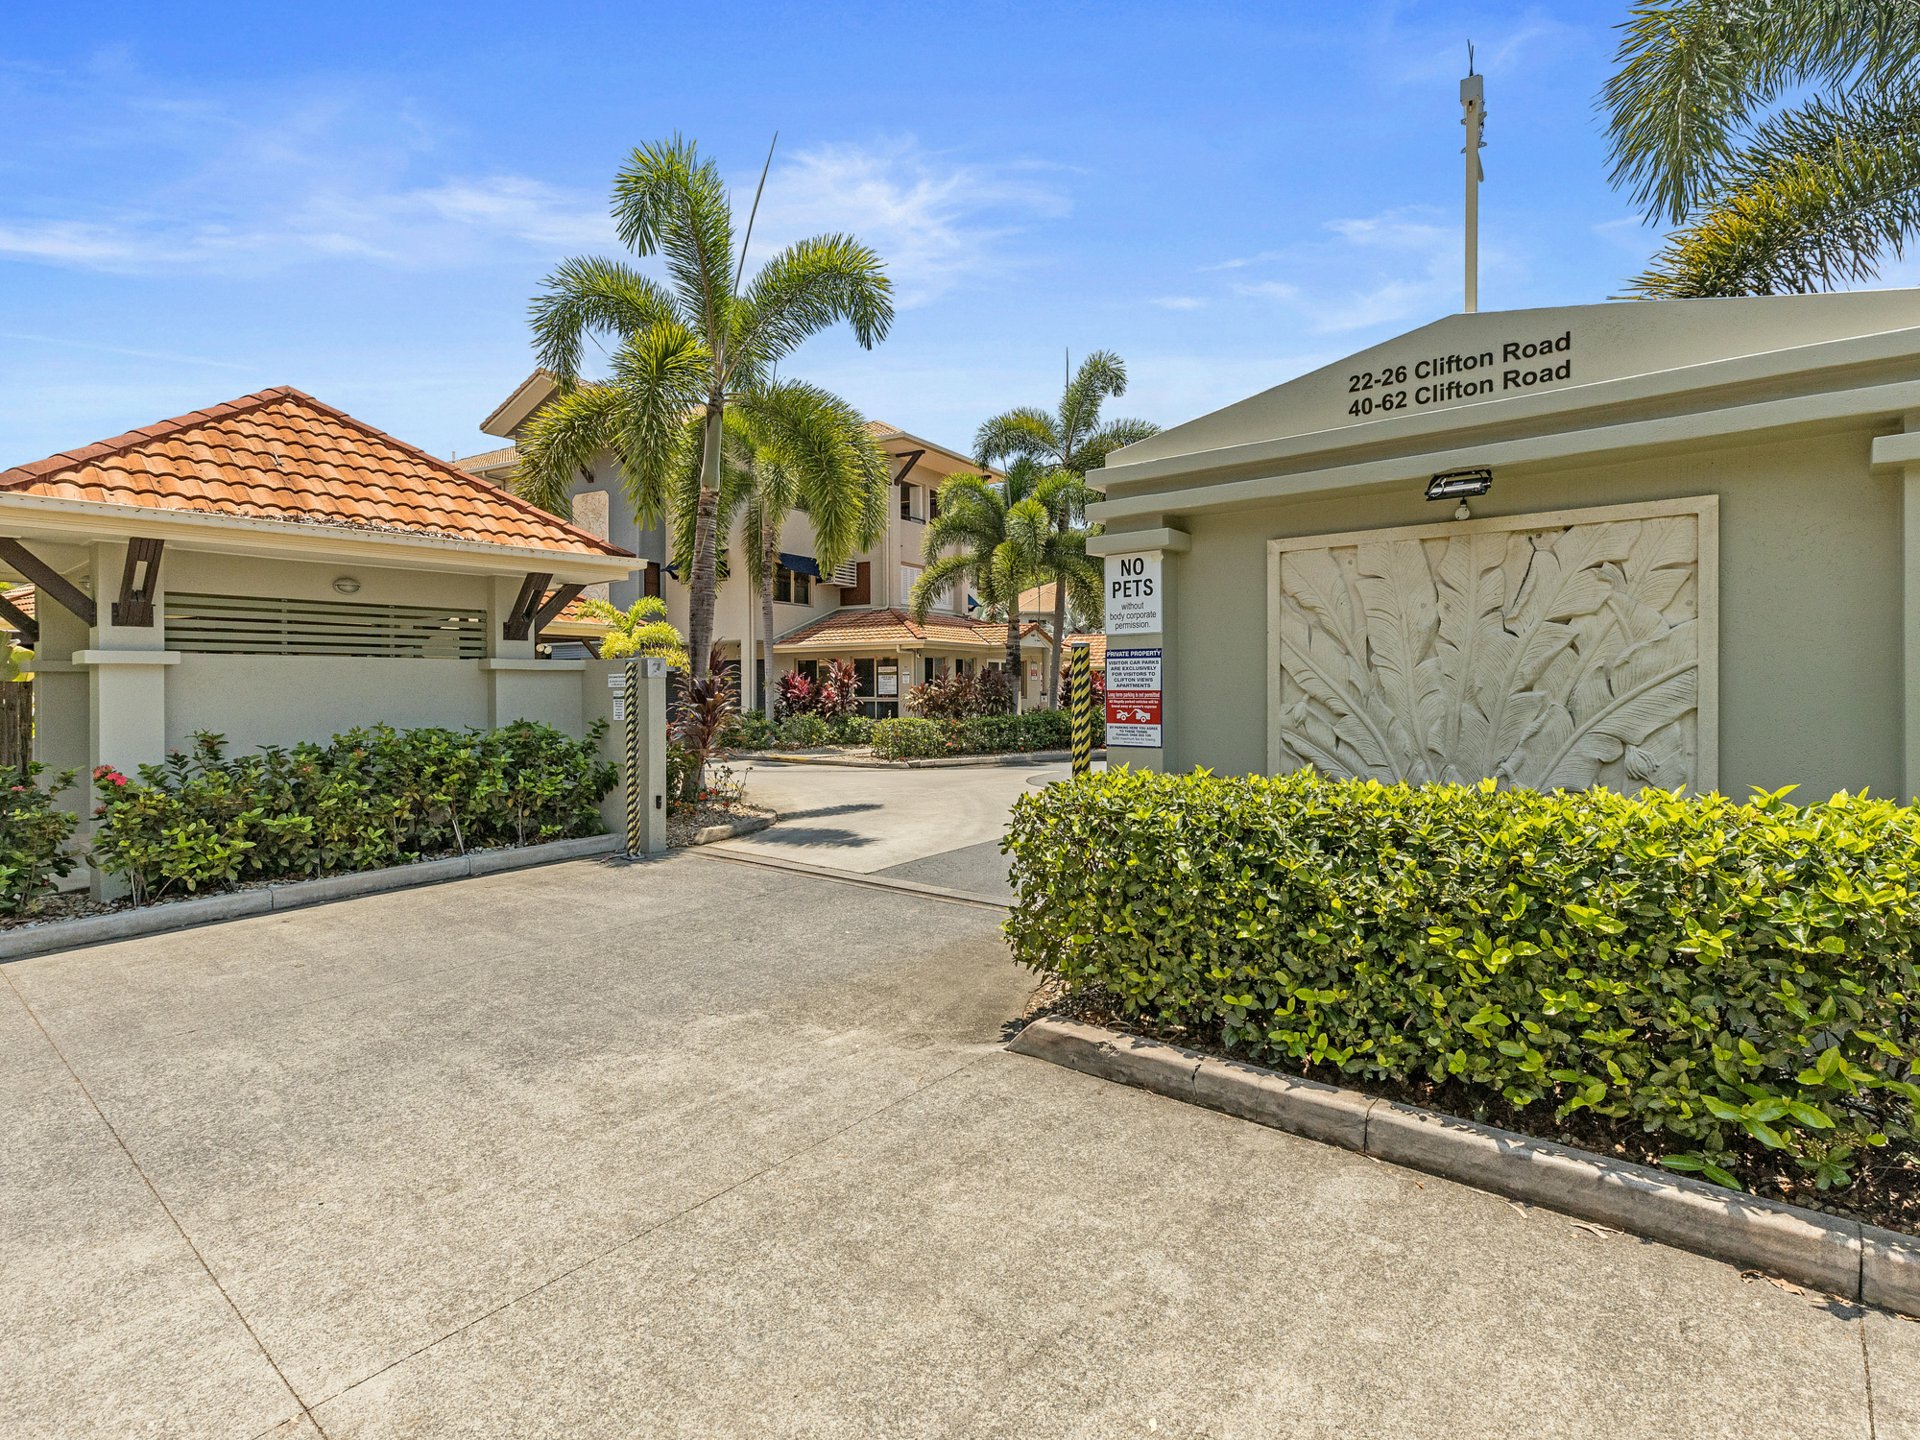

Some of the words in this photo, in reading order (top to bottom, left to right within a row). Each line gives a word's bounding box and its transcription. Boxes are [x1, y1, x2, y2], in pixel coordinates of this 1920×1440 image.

[1348, 366, 1407, 393] 22-26
[1414, 351, 1494, 380] Clifton
[1502, 331, 1571, 363] Road
[1348, 390, 1407, 417] 40-62
[1414, 378, 1494, 405] Clifton
[1502, 360, 1571, 390] Road
[1121, 557, 1144, 577] NO
[1112, 578, 1154, 599] PETS
[1121, 602, 1144, 610] without
[1110, 612, 1125, 622] body
[1126, 611, 1157, 621] corporate
[1115, 621, 1151, 631] permission.
